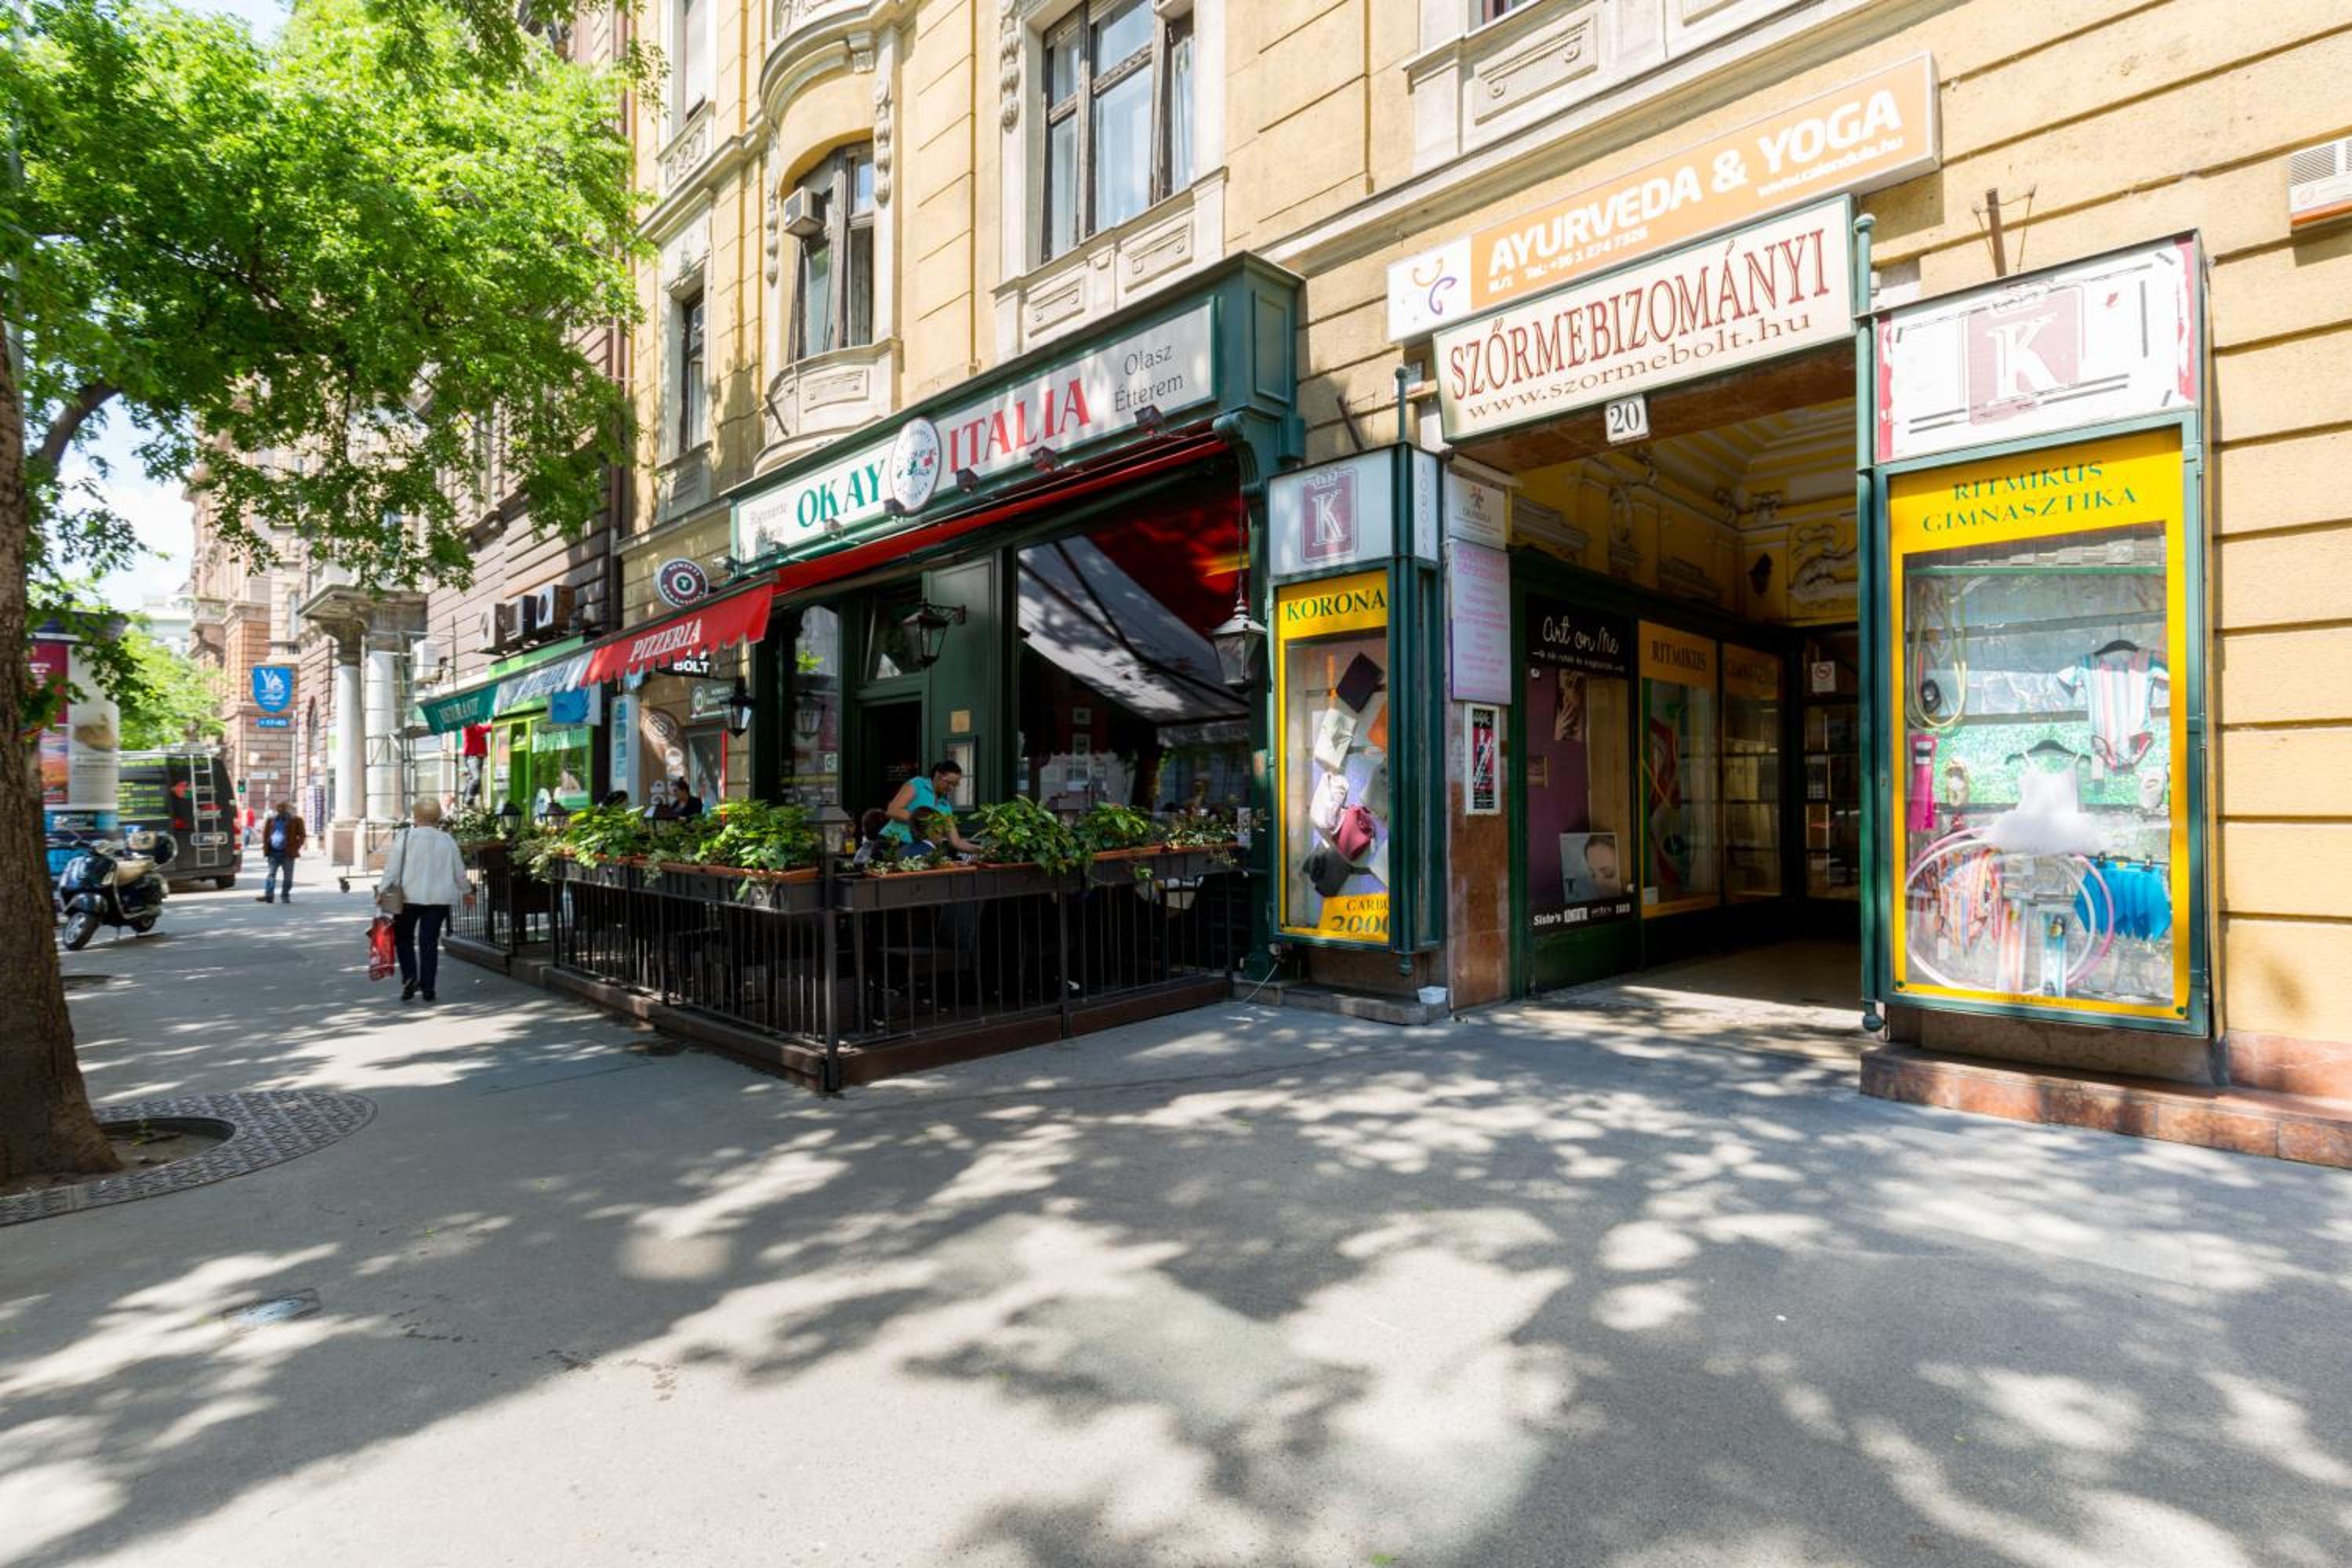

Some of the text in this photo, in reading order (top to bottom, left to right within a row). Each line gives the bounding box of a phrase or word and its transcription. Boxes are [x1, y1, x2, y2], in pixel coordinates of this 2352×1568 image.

[1489, 89, 1903, 277] AYURVEDA & YOGA
[1451, 228, 1830, 401] SZŐRMEBIZOMÁNYI
[1123, 343, 1173, 376] Olasz
[1468, 313, 1811, 420] www.szormebolt.hu
[1985, 312, 2060, 407] K
[1115, 372, 1184, 412] Étterem
[1610, 402, 1641, 434] 20
[797, 377, 1091, 528] OKAY ITALIA
[1953, 460, 2103, 501] RITMIKUS
[1312, 489, 1347, 547] K
[1923, 486, 2136, 532] GIMNASZTIKA
[1287, 589, 1386, 622] KORONA
[628, 618, 702, 662] PIZZERIA
[1575, 631, 1595, 652] on
[673, 660, 710, 673] BOLT
